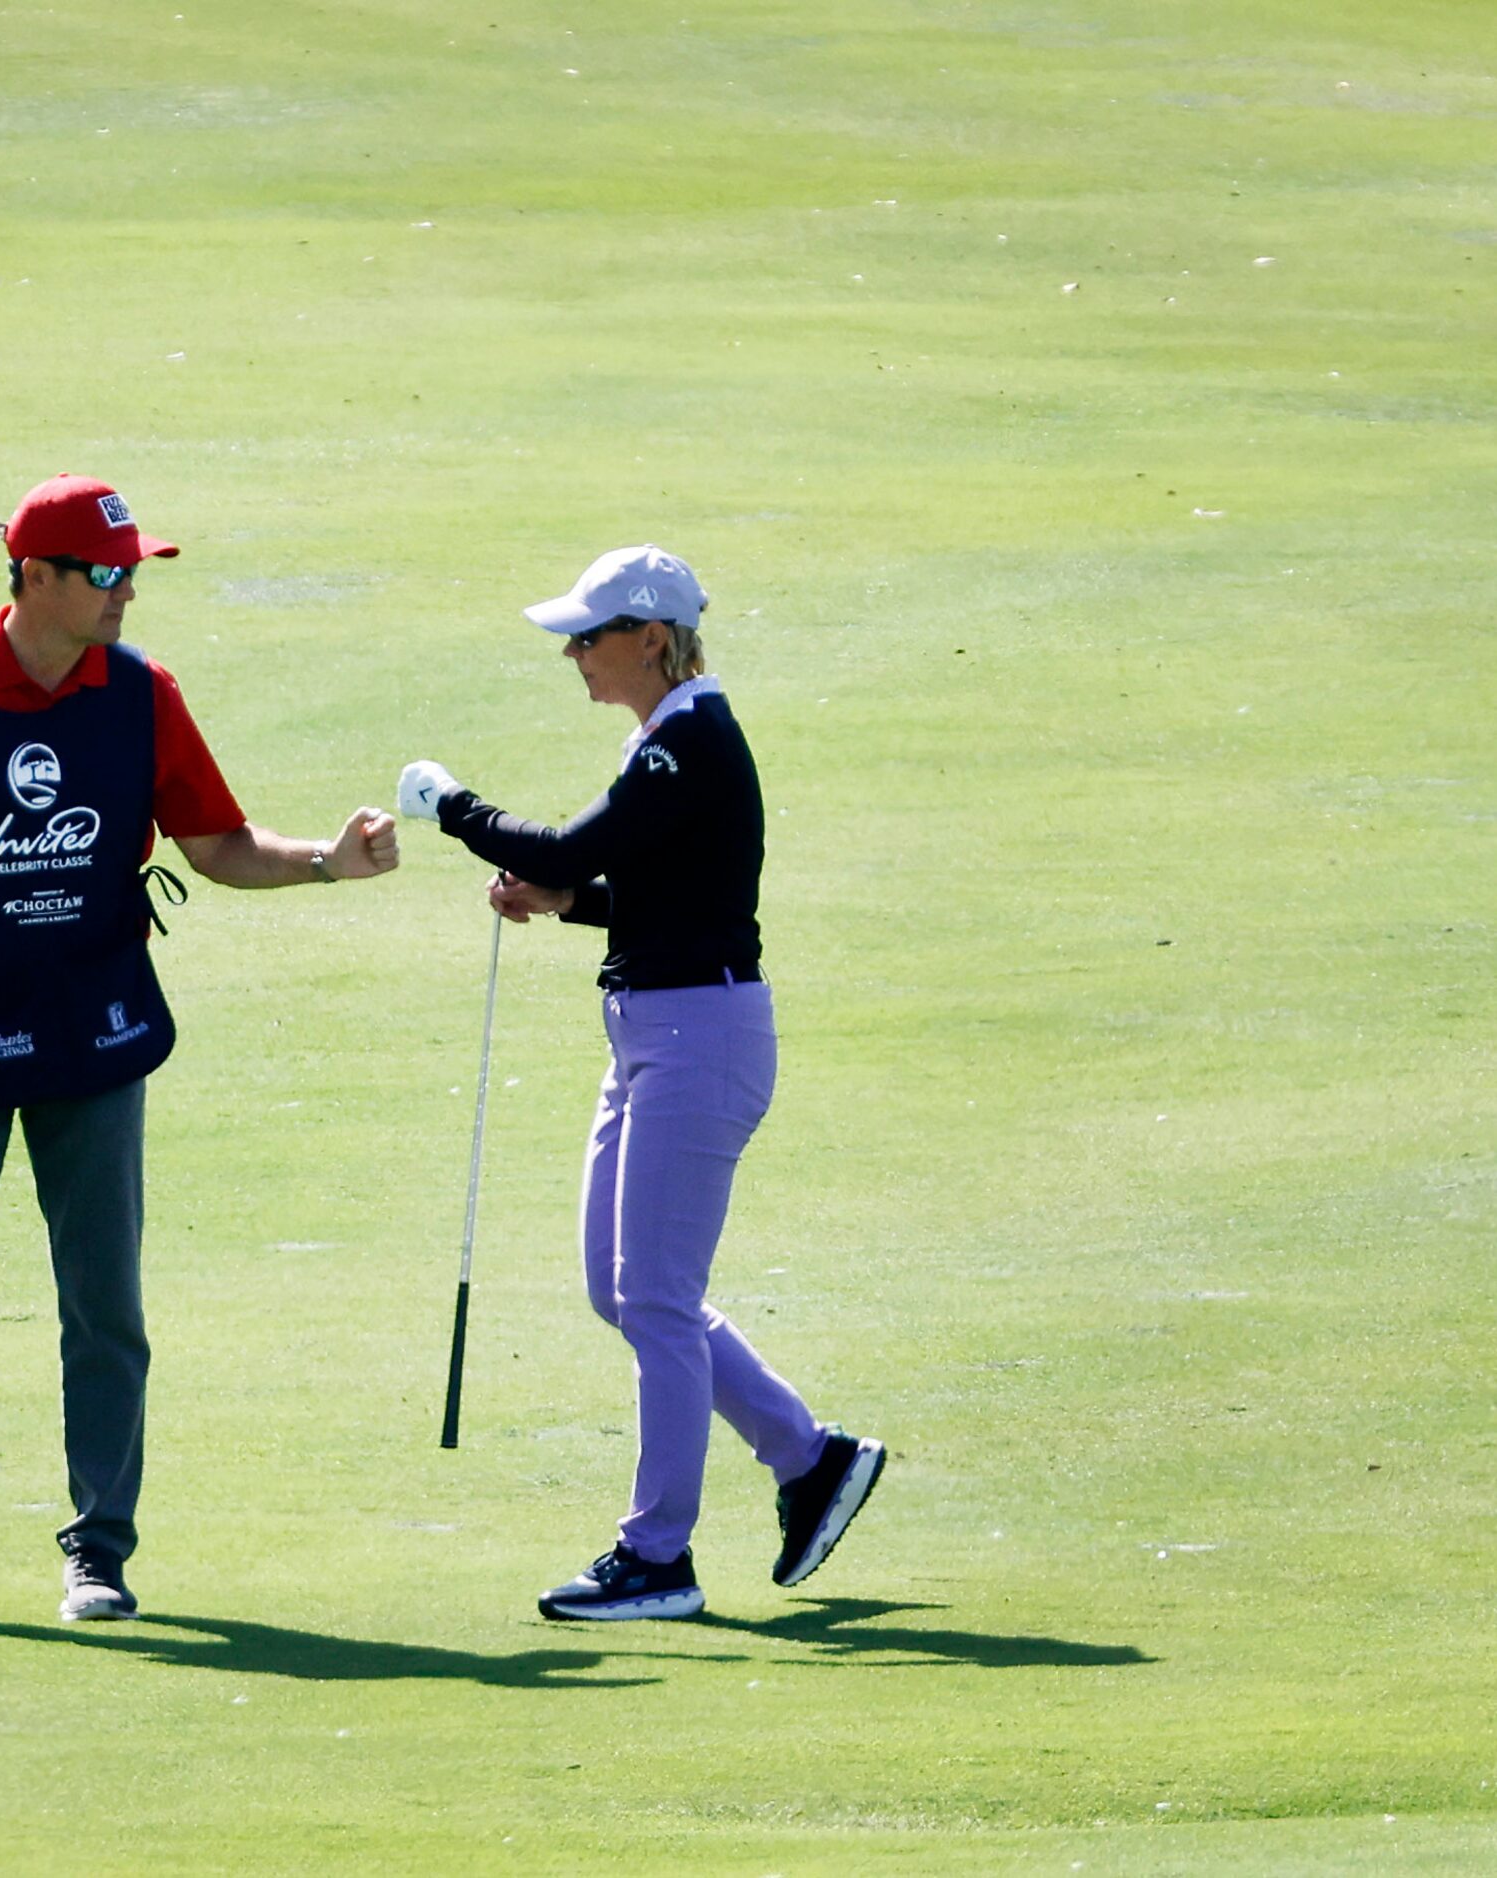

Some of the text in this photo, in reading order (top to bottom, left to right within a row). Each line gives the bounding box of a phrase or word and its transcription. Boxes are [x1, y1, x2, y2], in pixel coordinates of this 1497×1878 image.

[640, 744, 679, 772] Callaway
[51, 855, 93, 869] CLASSIC
[12, 896, 84, 913] CHOCTAW
